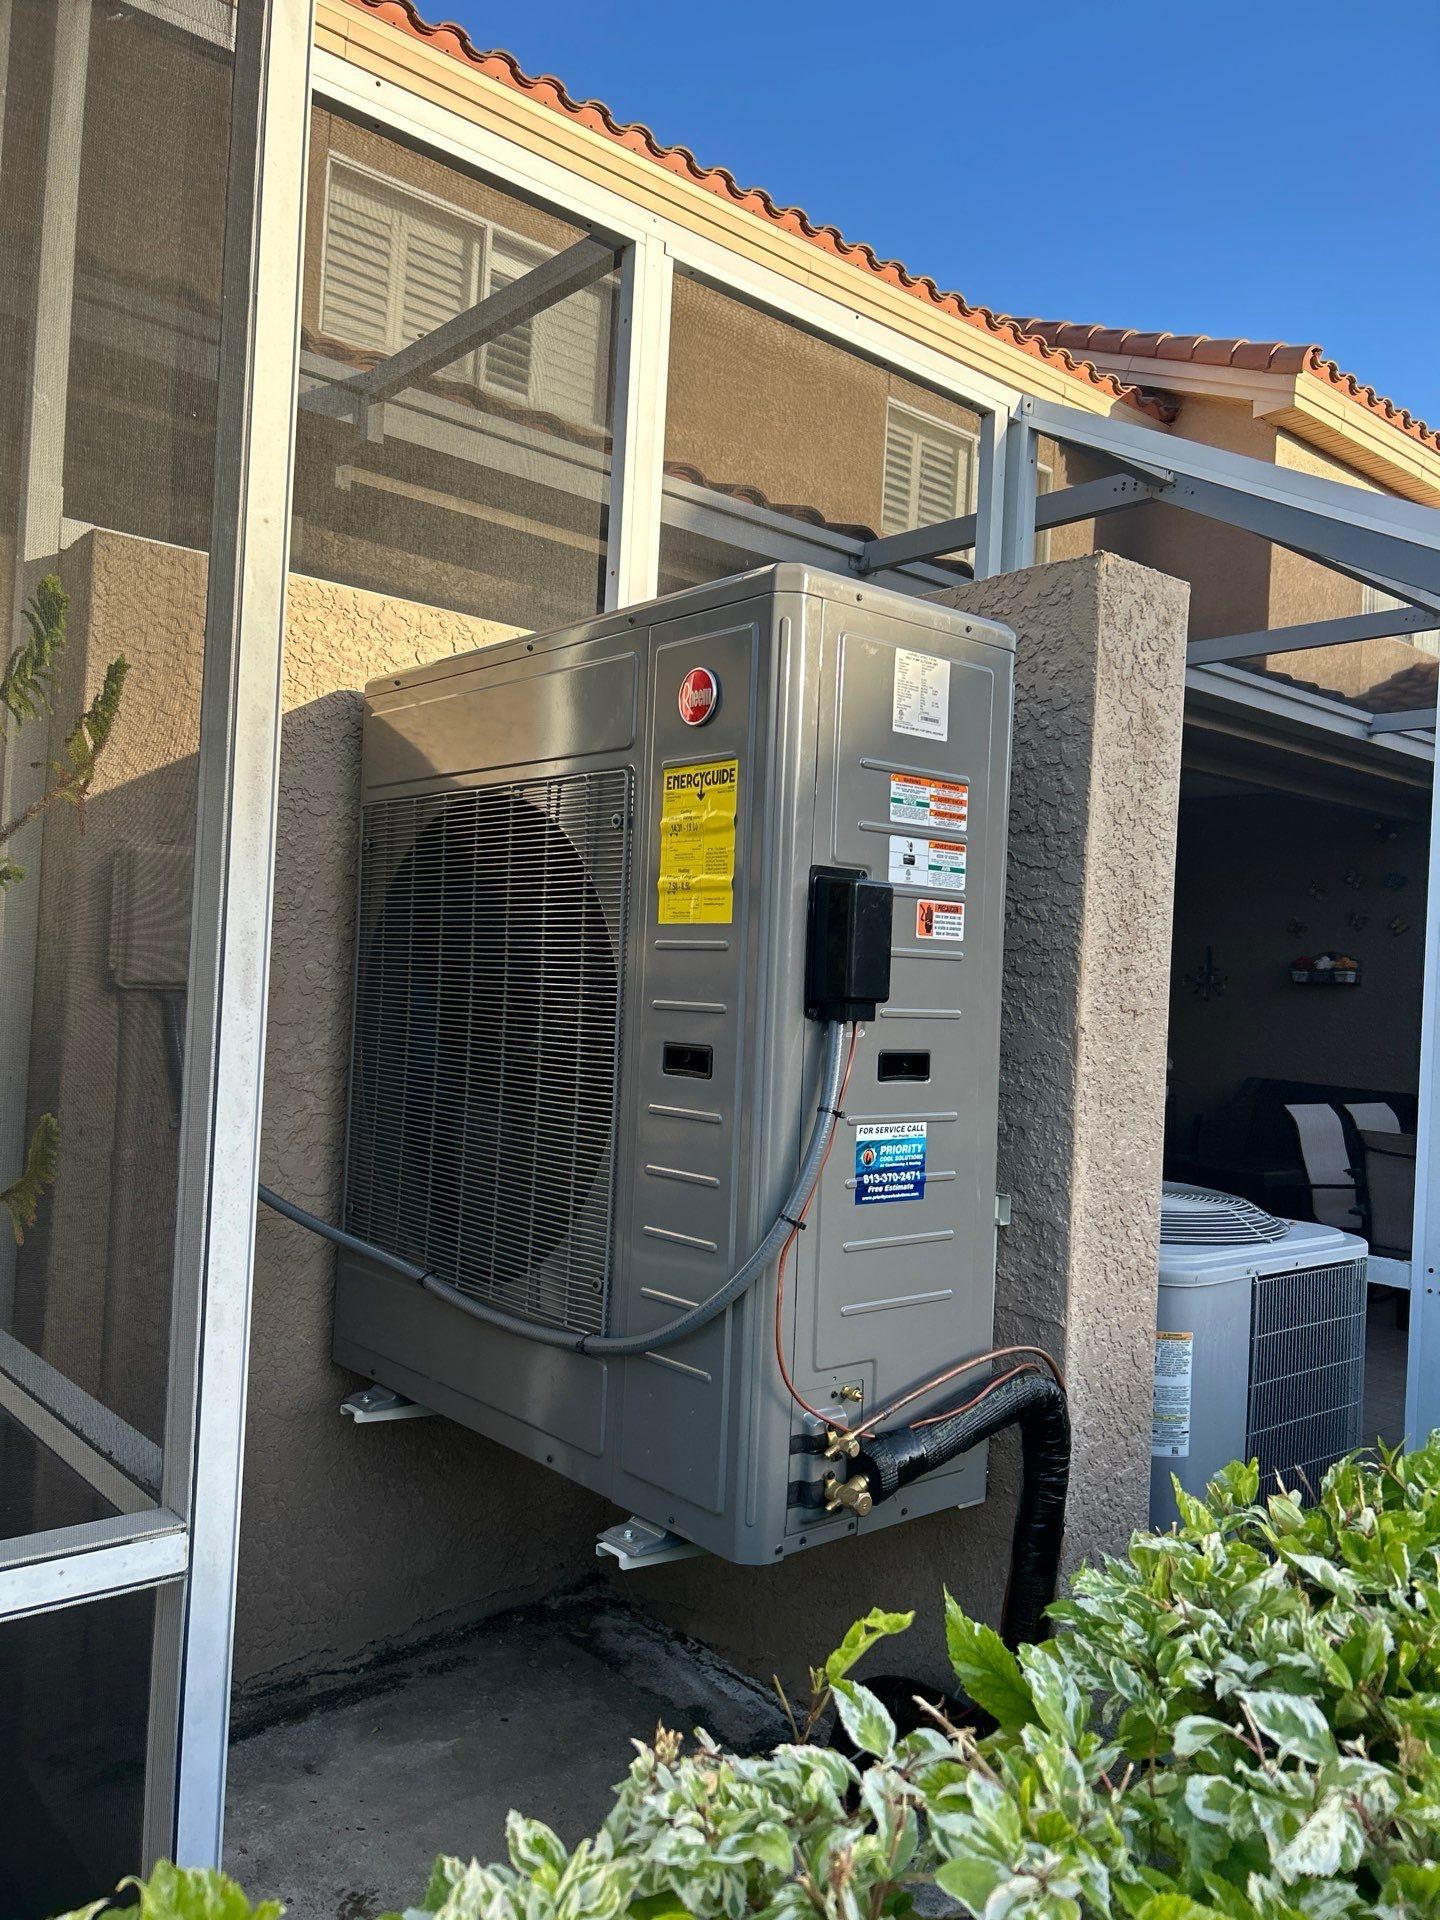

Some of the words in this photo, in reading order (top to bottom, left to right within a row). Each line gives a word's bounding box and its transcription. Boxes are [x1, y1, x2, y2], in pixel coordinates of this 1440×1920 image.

[682, 673, 711, 714] Rheem
[666, 768, 736, 790] ENERGYGUIDE
[859, 1127, 874, 1135] FOR
[875, 1126, 905, 1134] SERVICE
[907, 1124, 924, 1132] CALL
[880, 1143, 923, 1156] PRIORITY
[895, 1153, 924, 1161] SOLUTIONS
[863, 1170, 920, 1184] 813-370-2471
[868, 1185, 883, 1193] Free
[884, 1183, 914, 1192] Estimate
